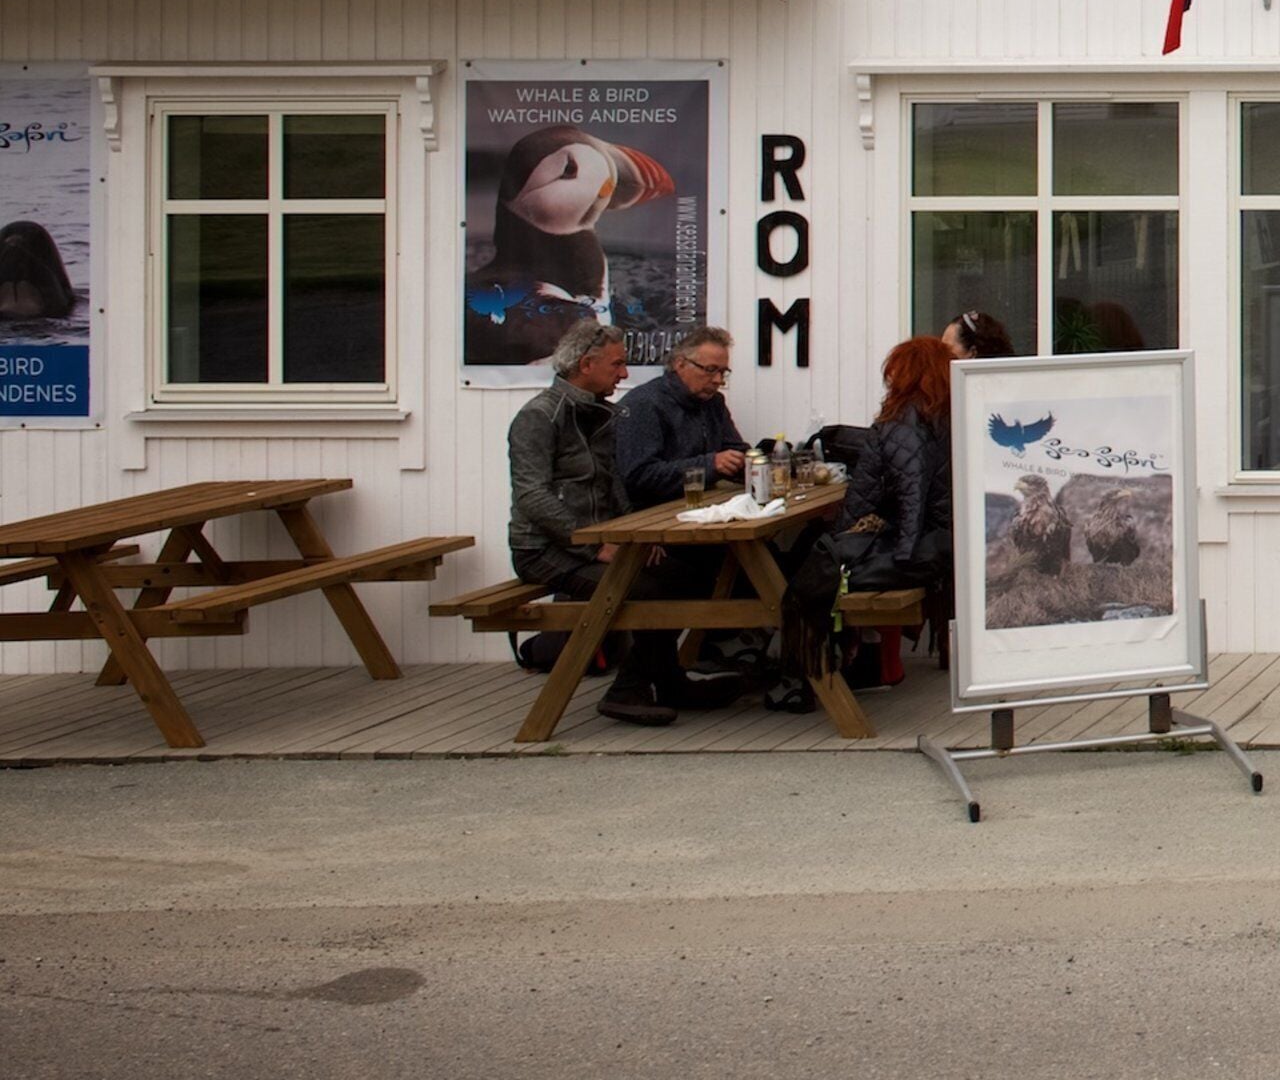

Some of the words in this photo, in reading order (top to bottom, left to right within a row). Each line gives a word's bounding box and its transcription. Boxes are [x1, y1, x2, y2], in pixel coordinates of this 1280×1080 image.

[516, 88, 584, 103] WHALE
[588, 88, 601, 103] &
[606, 88, 649, 103] BIRD
[487, 108, 584, 123] WATCHING
[591, 108, 678, 123] ANDENES
[757, 134, 810, 368] ROM
[637, 331, 657, 363] 916
[0, 357, 45, 376] BIRD
[1002, 460, 1035, 471] WHALE
[1046, 467, 1067, 477] BIRD
